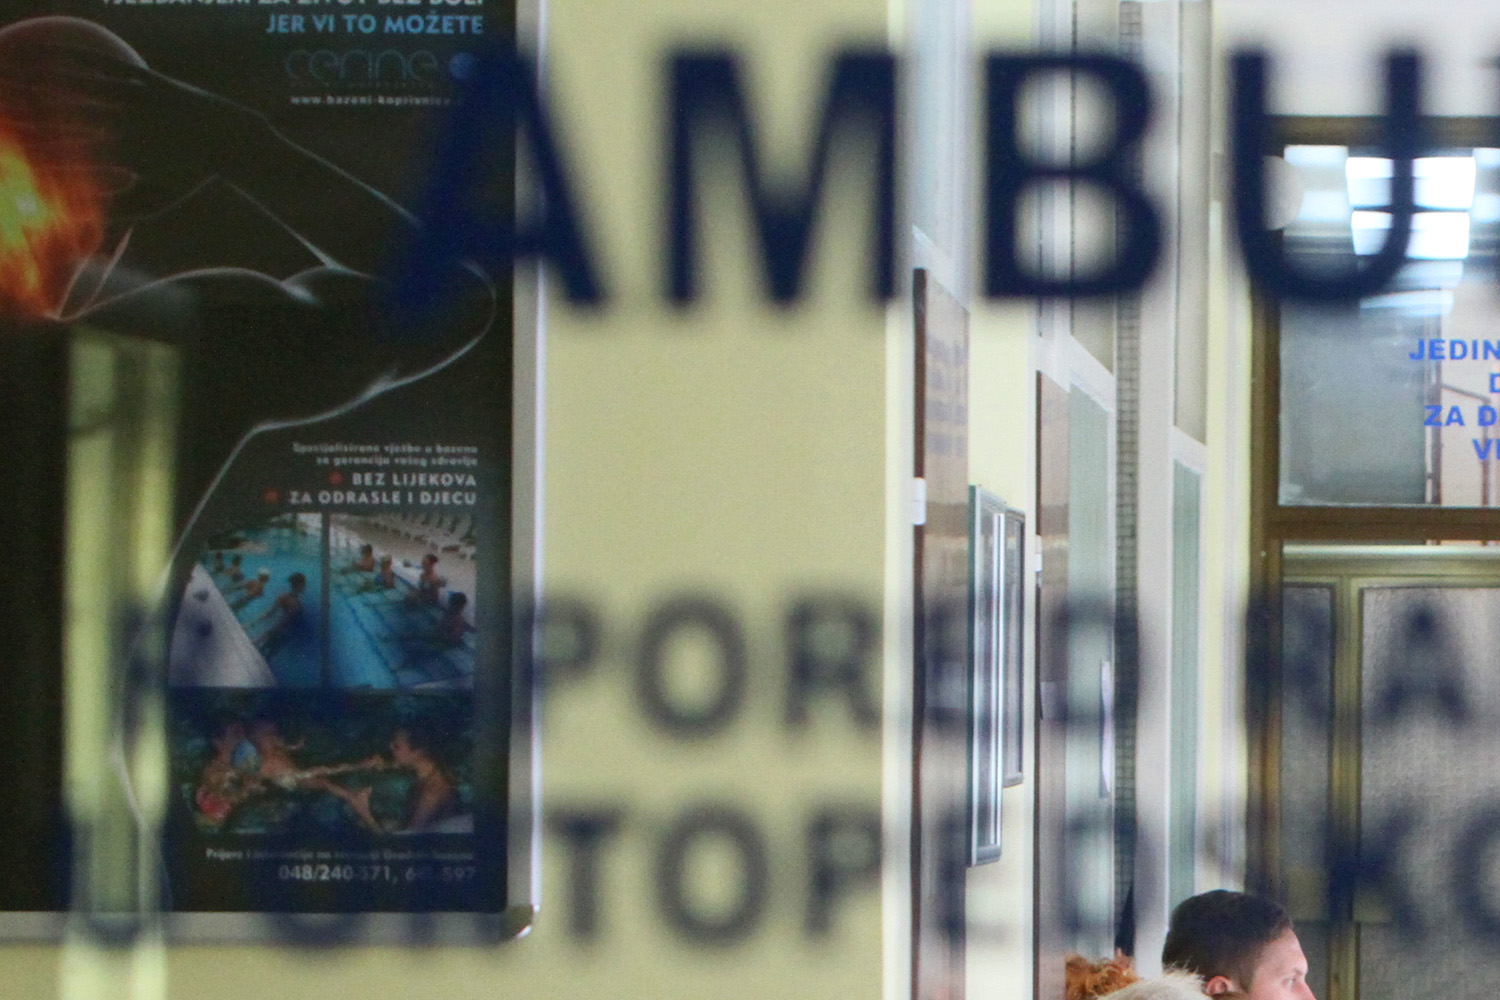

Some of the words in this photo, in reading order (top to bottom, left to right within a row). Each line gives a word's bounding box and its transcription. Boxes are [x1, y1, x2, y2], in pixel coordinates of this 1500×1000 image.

[266, 15, 306, 34] JER
[312, 15, 335, 34] VI
[343, 15, 376, 34] TO
[384, 10, 484, 35] MOŽETE
[1424, 405, 1466, 427] ZA
[352, 472, 386, 487] BEZ
[392, 472, 478, 487] LIJEKOVA
[289, 490, 310, 505] ZA
[318, 490, 401, 505] ODRASLE
[419, 490, 478, 506] DJECU
